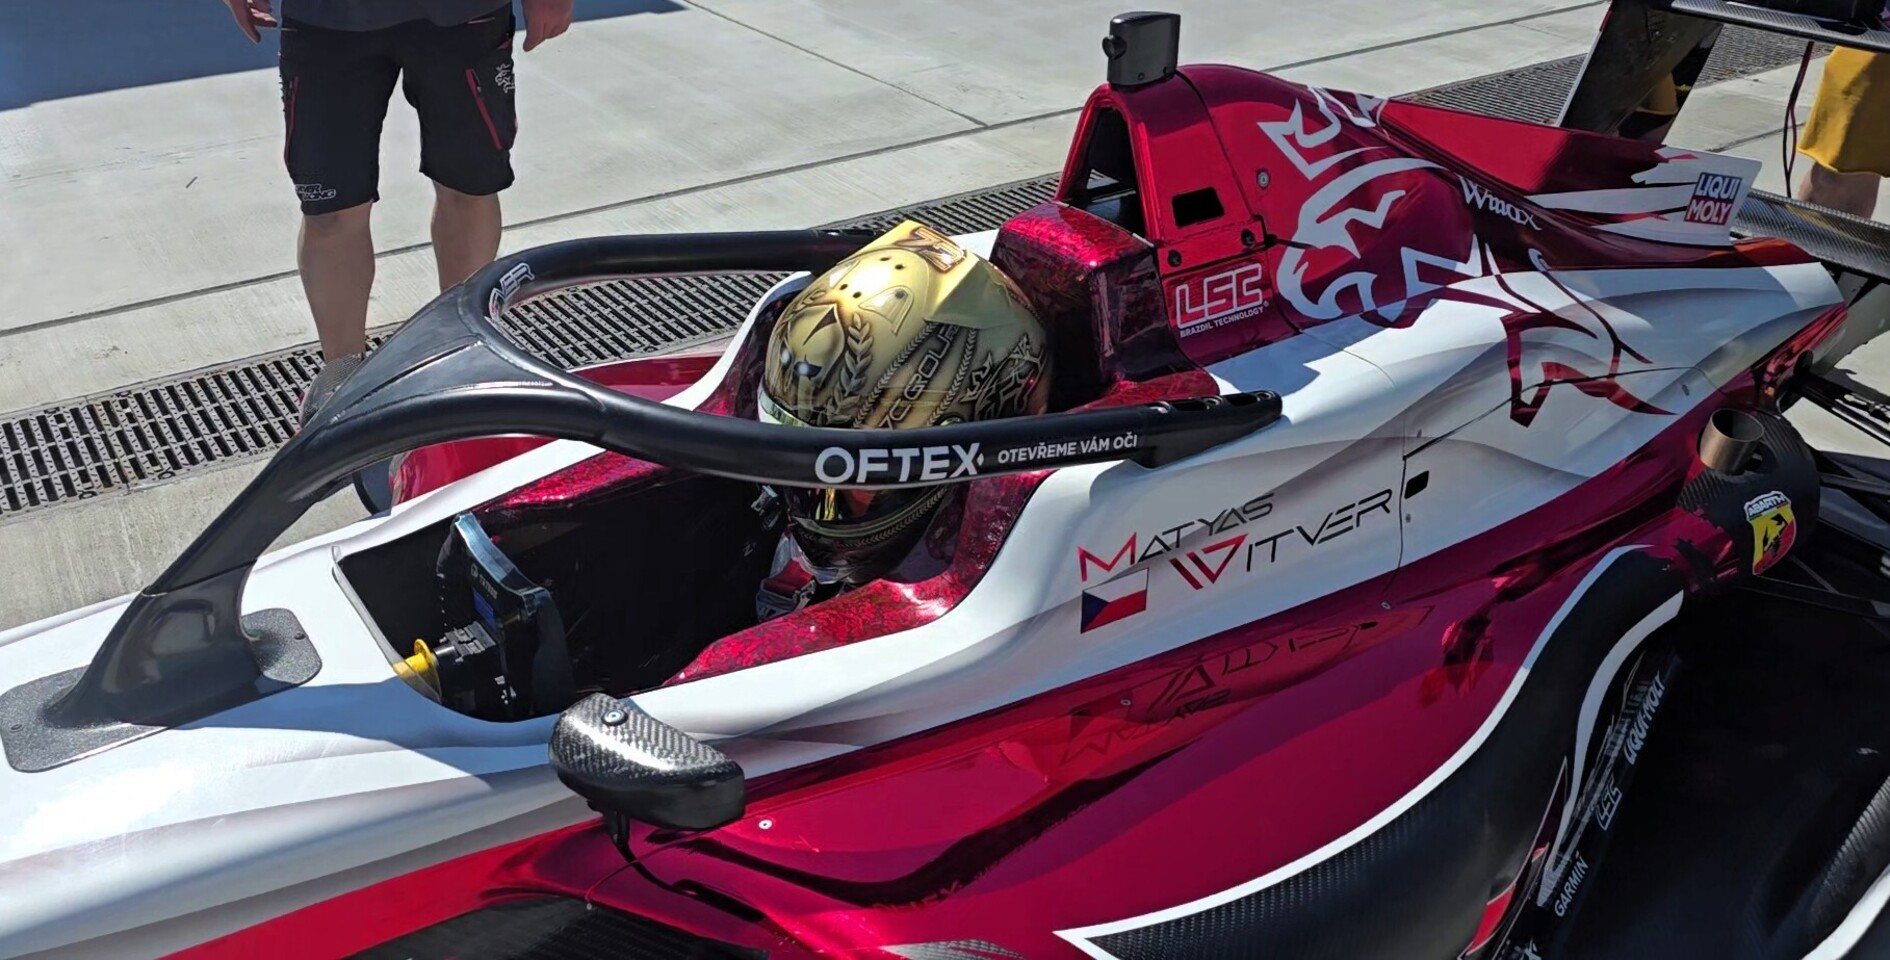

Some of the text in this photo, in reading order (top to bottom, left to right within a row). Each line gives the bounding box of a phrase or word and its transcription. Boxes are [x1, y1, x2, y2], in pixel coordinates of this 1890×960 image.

[1694, 174, 1740, 199] LIQUI
[1685, 199, 1732, 223] MOLY
[1214, 306, 1264, 328] TECHNOLOGY
[814, 432, 1138, 484] OFTEX OTEVŘEME VÁM OČI
[1748, 495, 1785, 516] ABARTH
[1077, 493, 1275, 582] MATYAS
[1554, 855, 1589, 917] GARMIN
